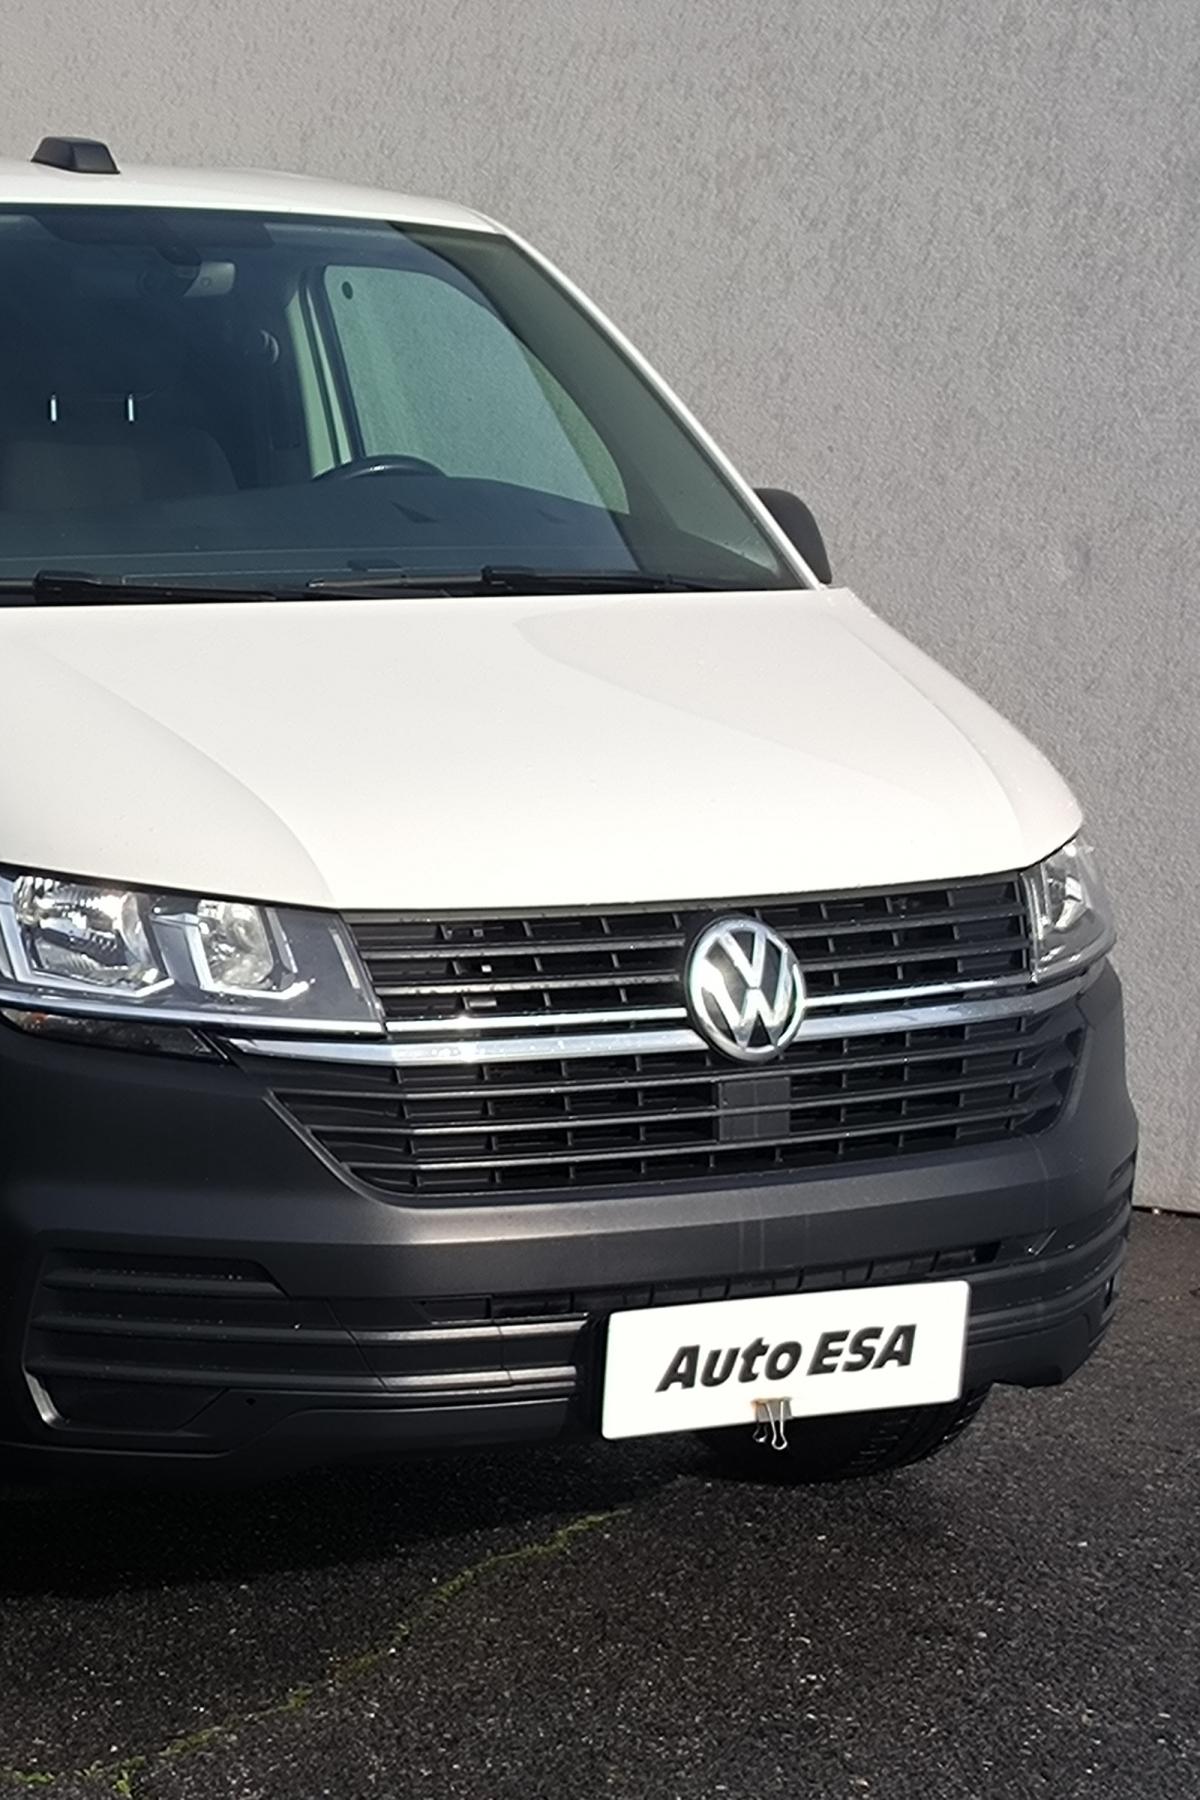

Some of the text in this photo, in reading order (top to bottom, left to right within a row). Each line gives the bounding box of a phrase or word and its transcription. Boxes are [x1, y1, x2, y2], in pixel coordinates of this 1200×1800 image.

[689, 919, 804, 1060] VW
[655, 1323, 918, 1393] Auto ESA
